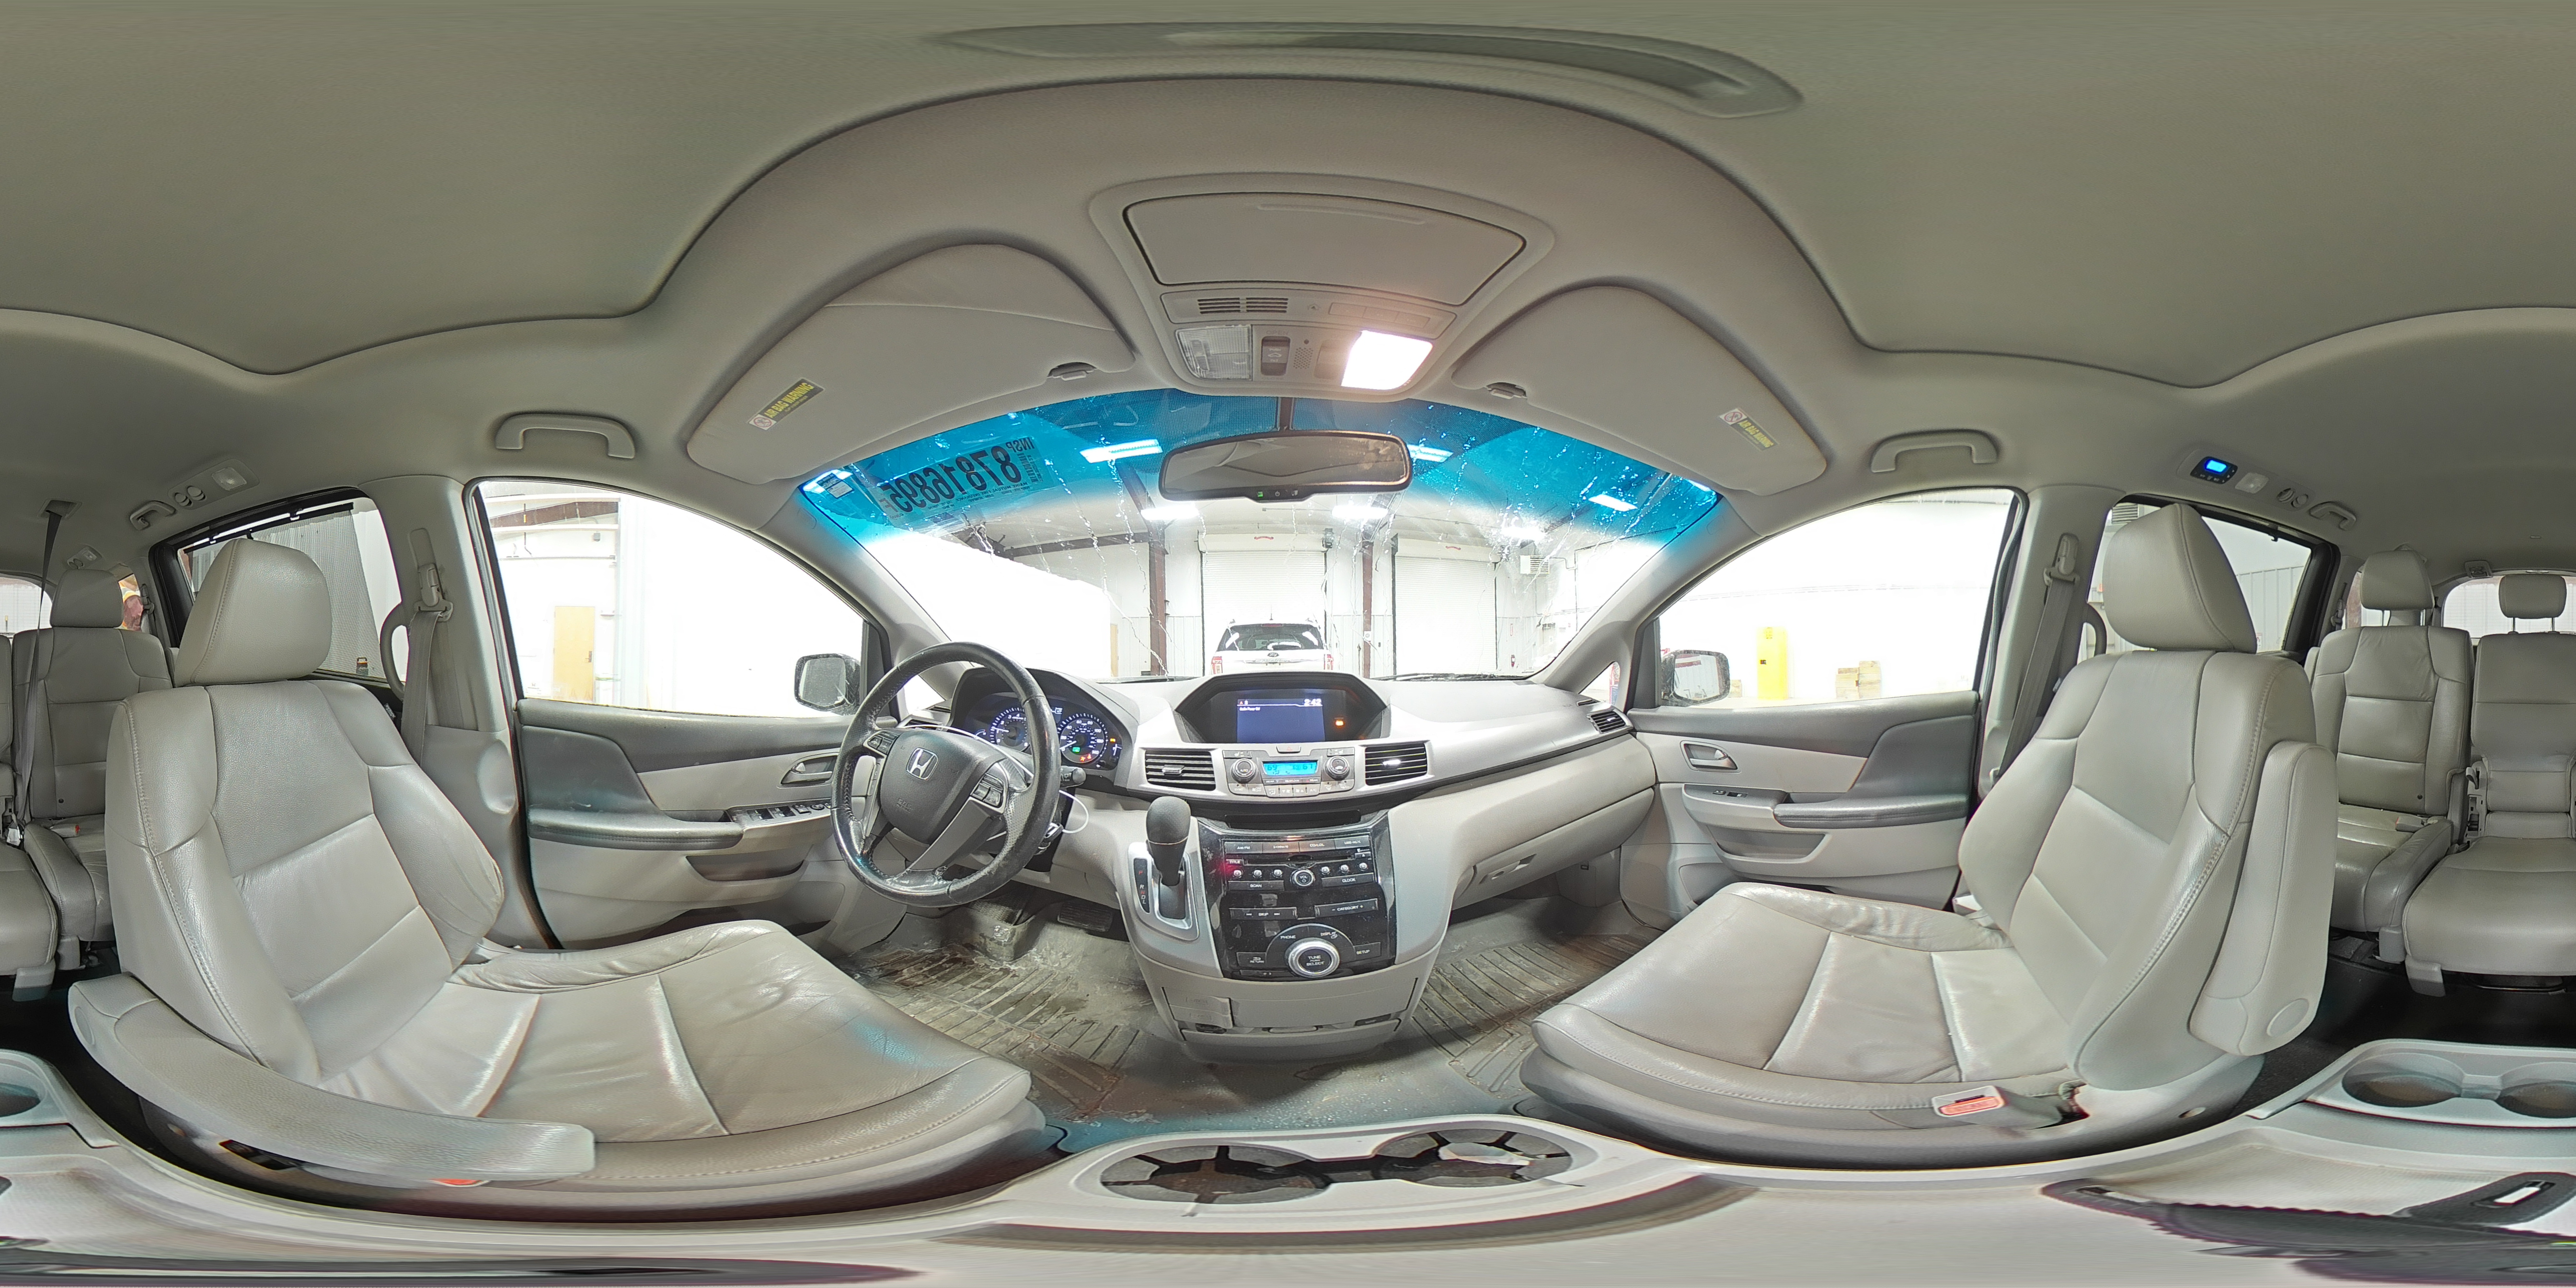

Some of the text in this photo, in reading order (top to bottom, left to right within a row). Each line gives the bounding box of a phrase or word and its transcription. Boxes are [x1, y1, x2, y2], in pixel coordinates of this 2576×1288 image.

[763, 406, 779, 418] AIR
[772, 401, 789, 412] BAG
[781, 382, 815, 403] WARNING
